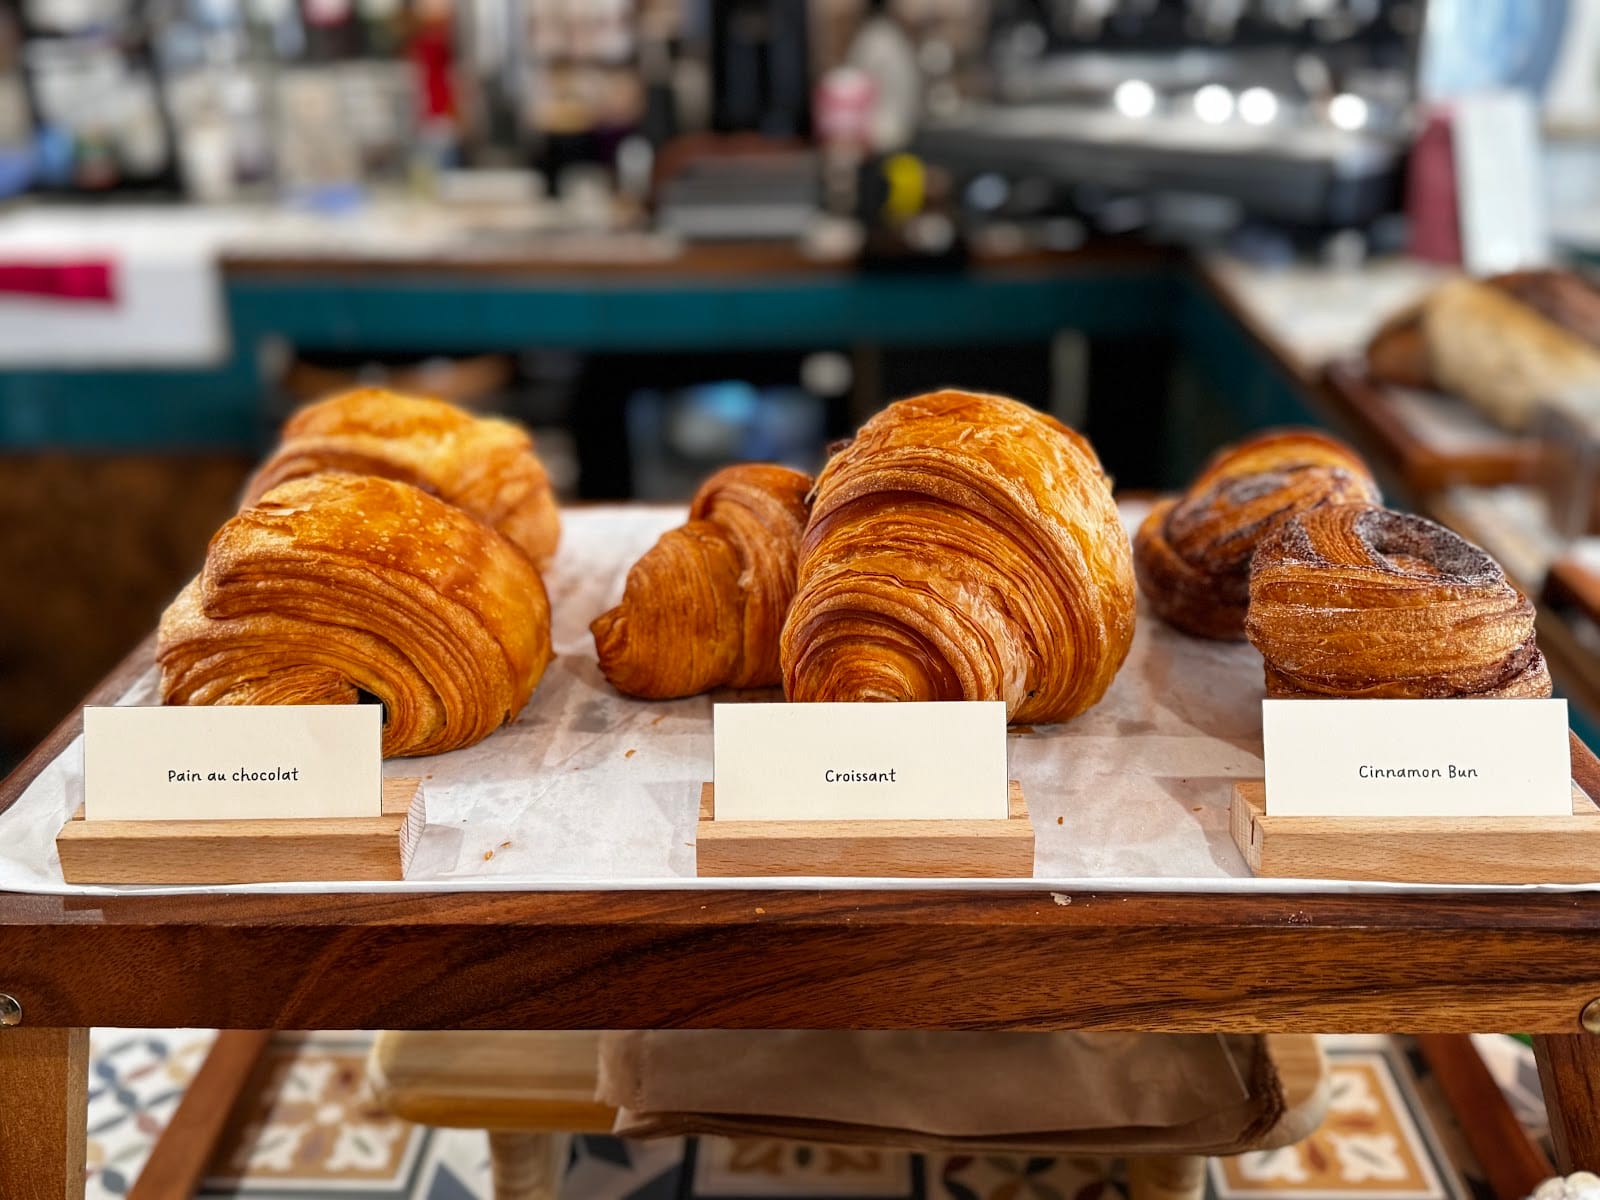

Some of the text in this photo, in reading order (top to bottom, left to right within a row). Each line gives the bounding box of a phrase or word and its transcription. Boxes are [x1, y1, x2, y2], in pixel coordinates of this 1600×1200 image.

[168, 766, 299, 783] Pain au chocolat
[825, 767, 896, 783] Croissant
[1359, 764, 1478, 779] Cinnamon Bun
